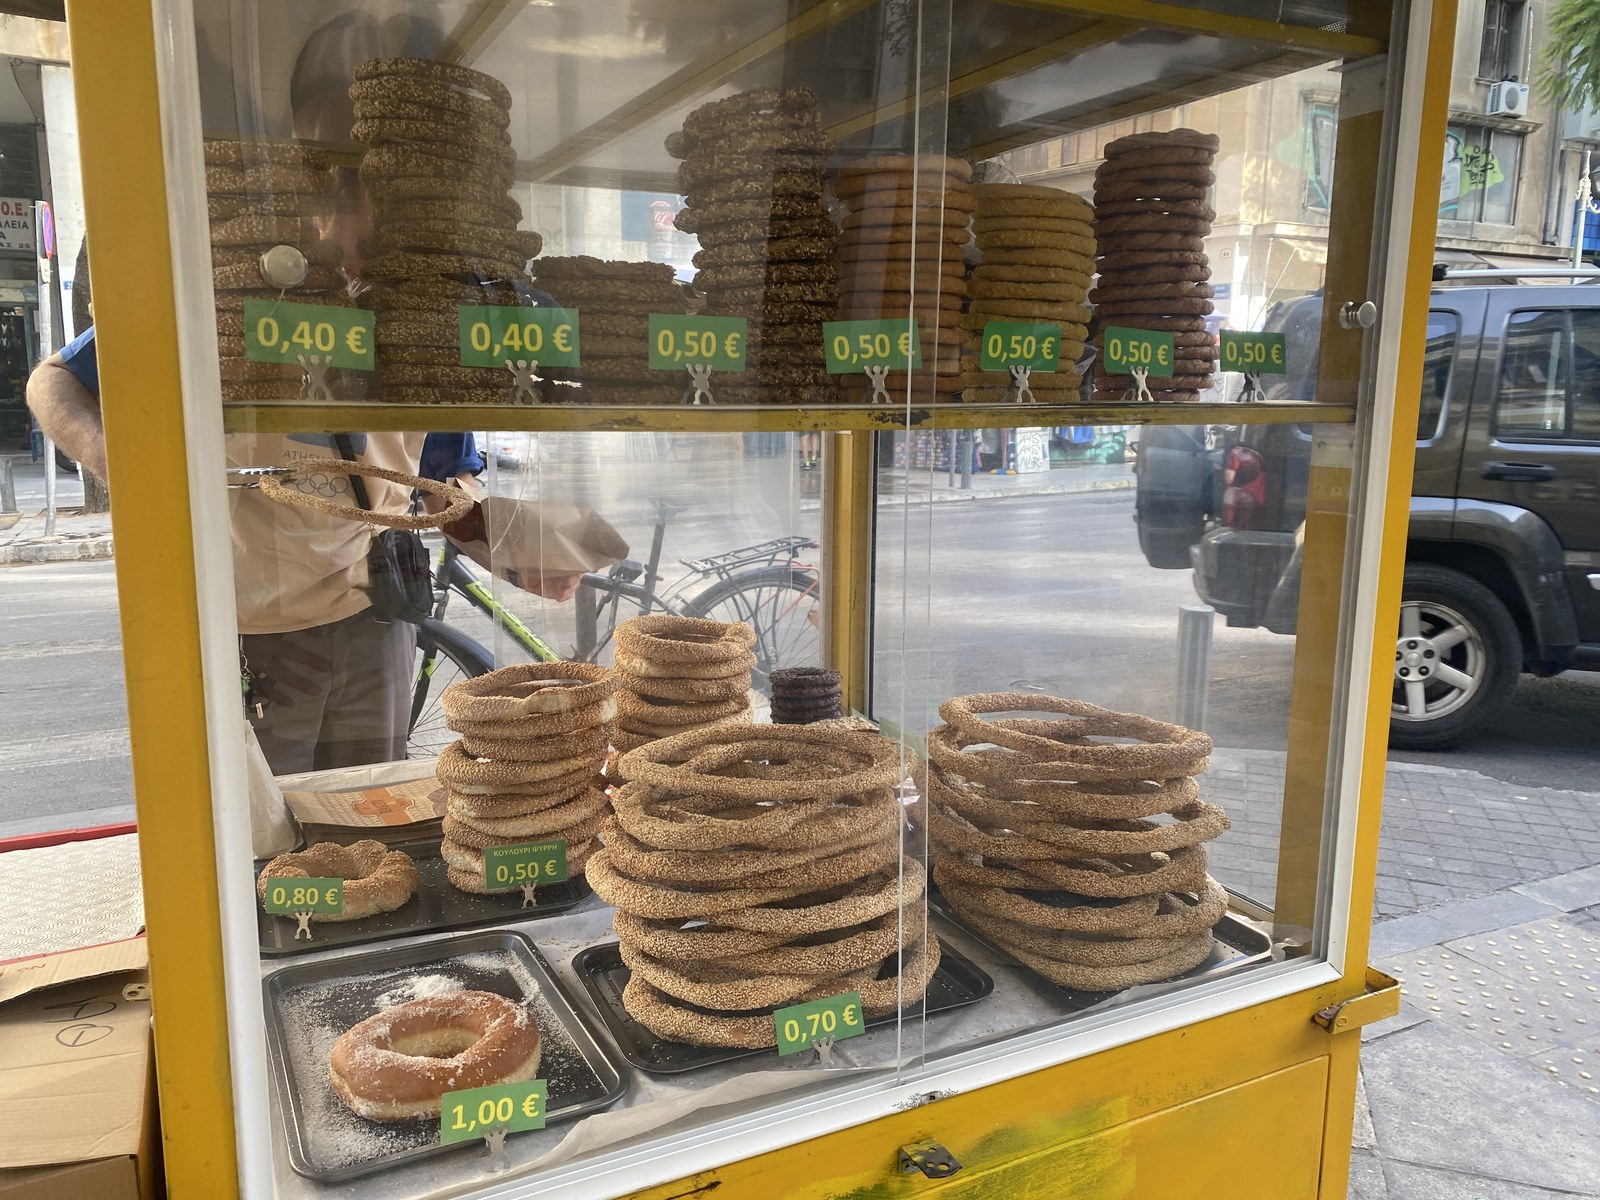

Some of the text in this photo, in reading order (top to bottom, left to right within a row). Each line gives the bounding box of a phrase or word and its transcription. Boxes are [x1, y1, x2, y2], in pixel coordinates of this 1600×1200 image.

[256, 316, 368, 355] 0,40 €
[471, 322, 574, 357] 0,40 €
[657, 328, 741, 361] 0,50 €
[834, 331, 916, 364] 0,50 €
[989, 334, 1056, 362] 0,50 €
[1110, 339, 1169, 366] 0,50 €
[1226, 342, 1282, 365] 0,50 €
[493, 844, 558, 857] ΚΟΥΛΟΥΡΙ ΨΥΡΡΗ
[496, 859, 557, 884] 0,50 €
[272, 886, 339, 908] 0,80 €
[784, 1003, 859, 1044] 0,70 €
[451, 1093, 541, 1134] 1,00 €
